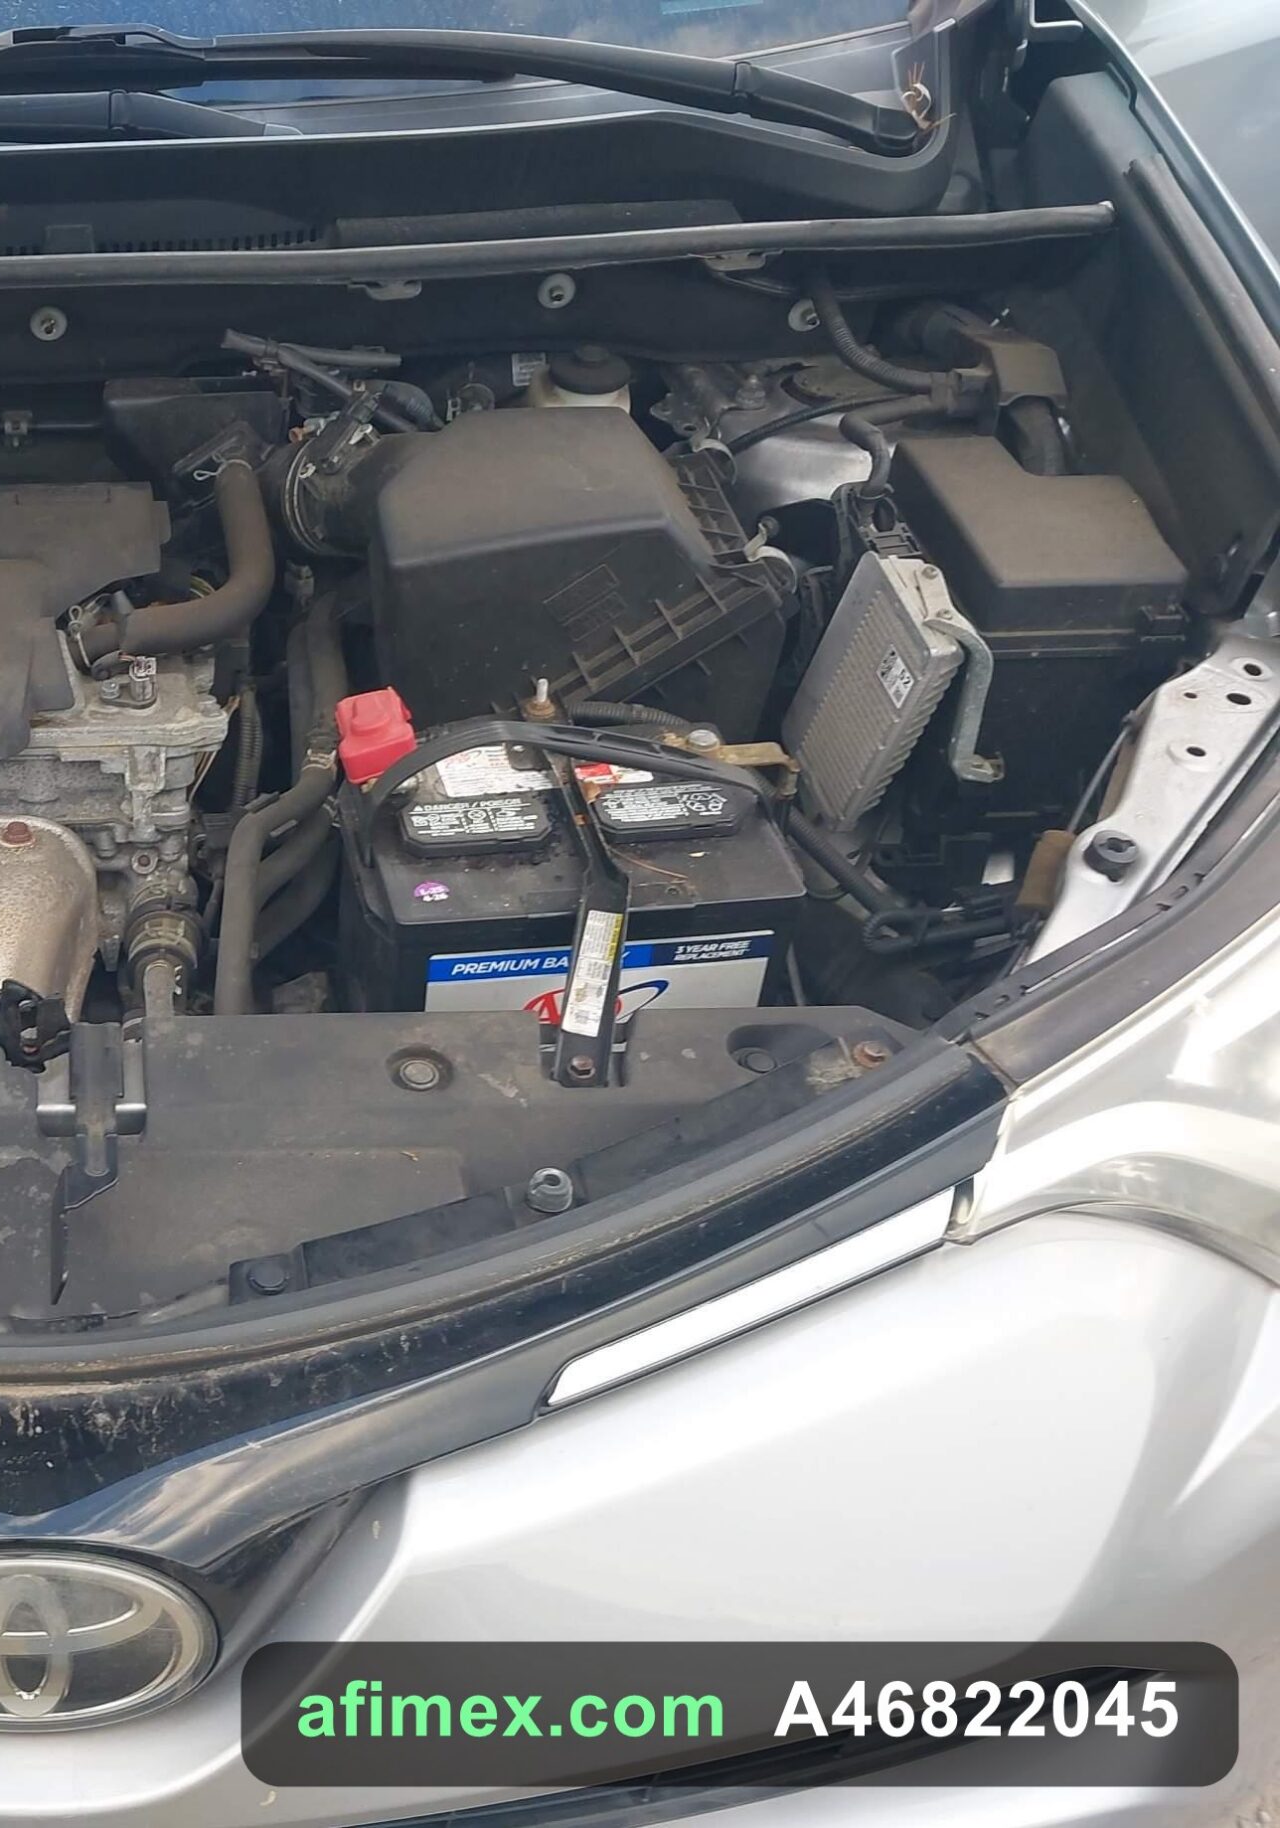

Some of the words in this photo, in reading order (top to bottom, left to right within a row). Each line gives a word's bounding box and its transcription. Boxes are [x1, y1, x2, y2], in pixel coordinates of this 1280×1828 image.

[686, 943, 717, 953] YEAR
[719, 940, 753, 951] FREE
[451, 957, 539, 976] PREMIUM
